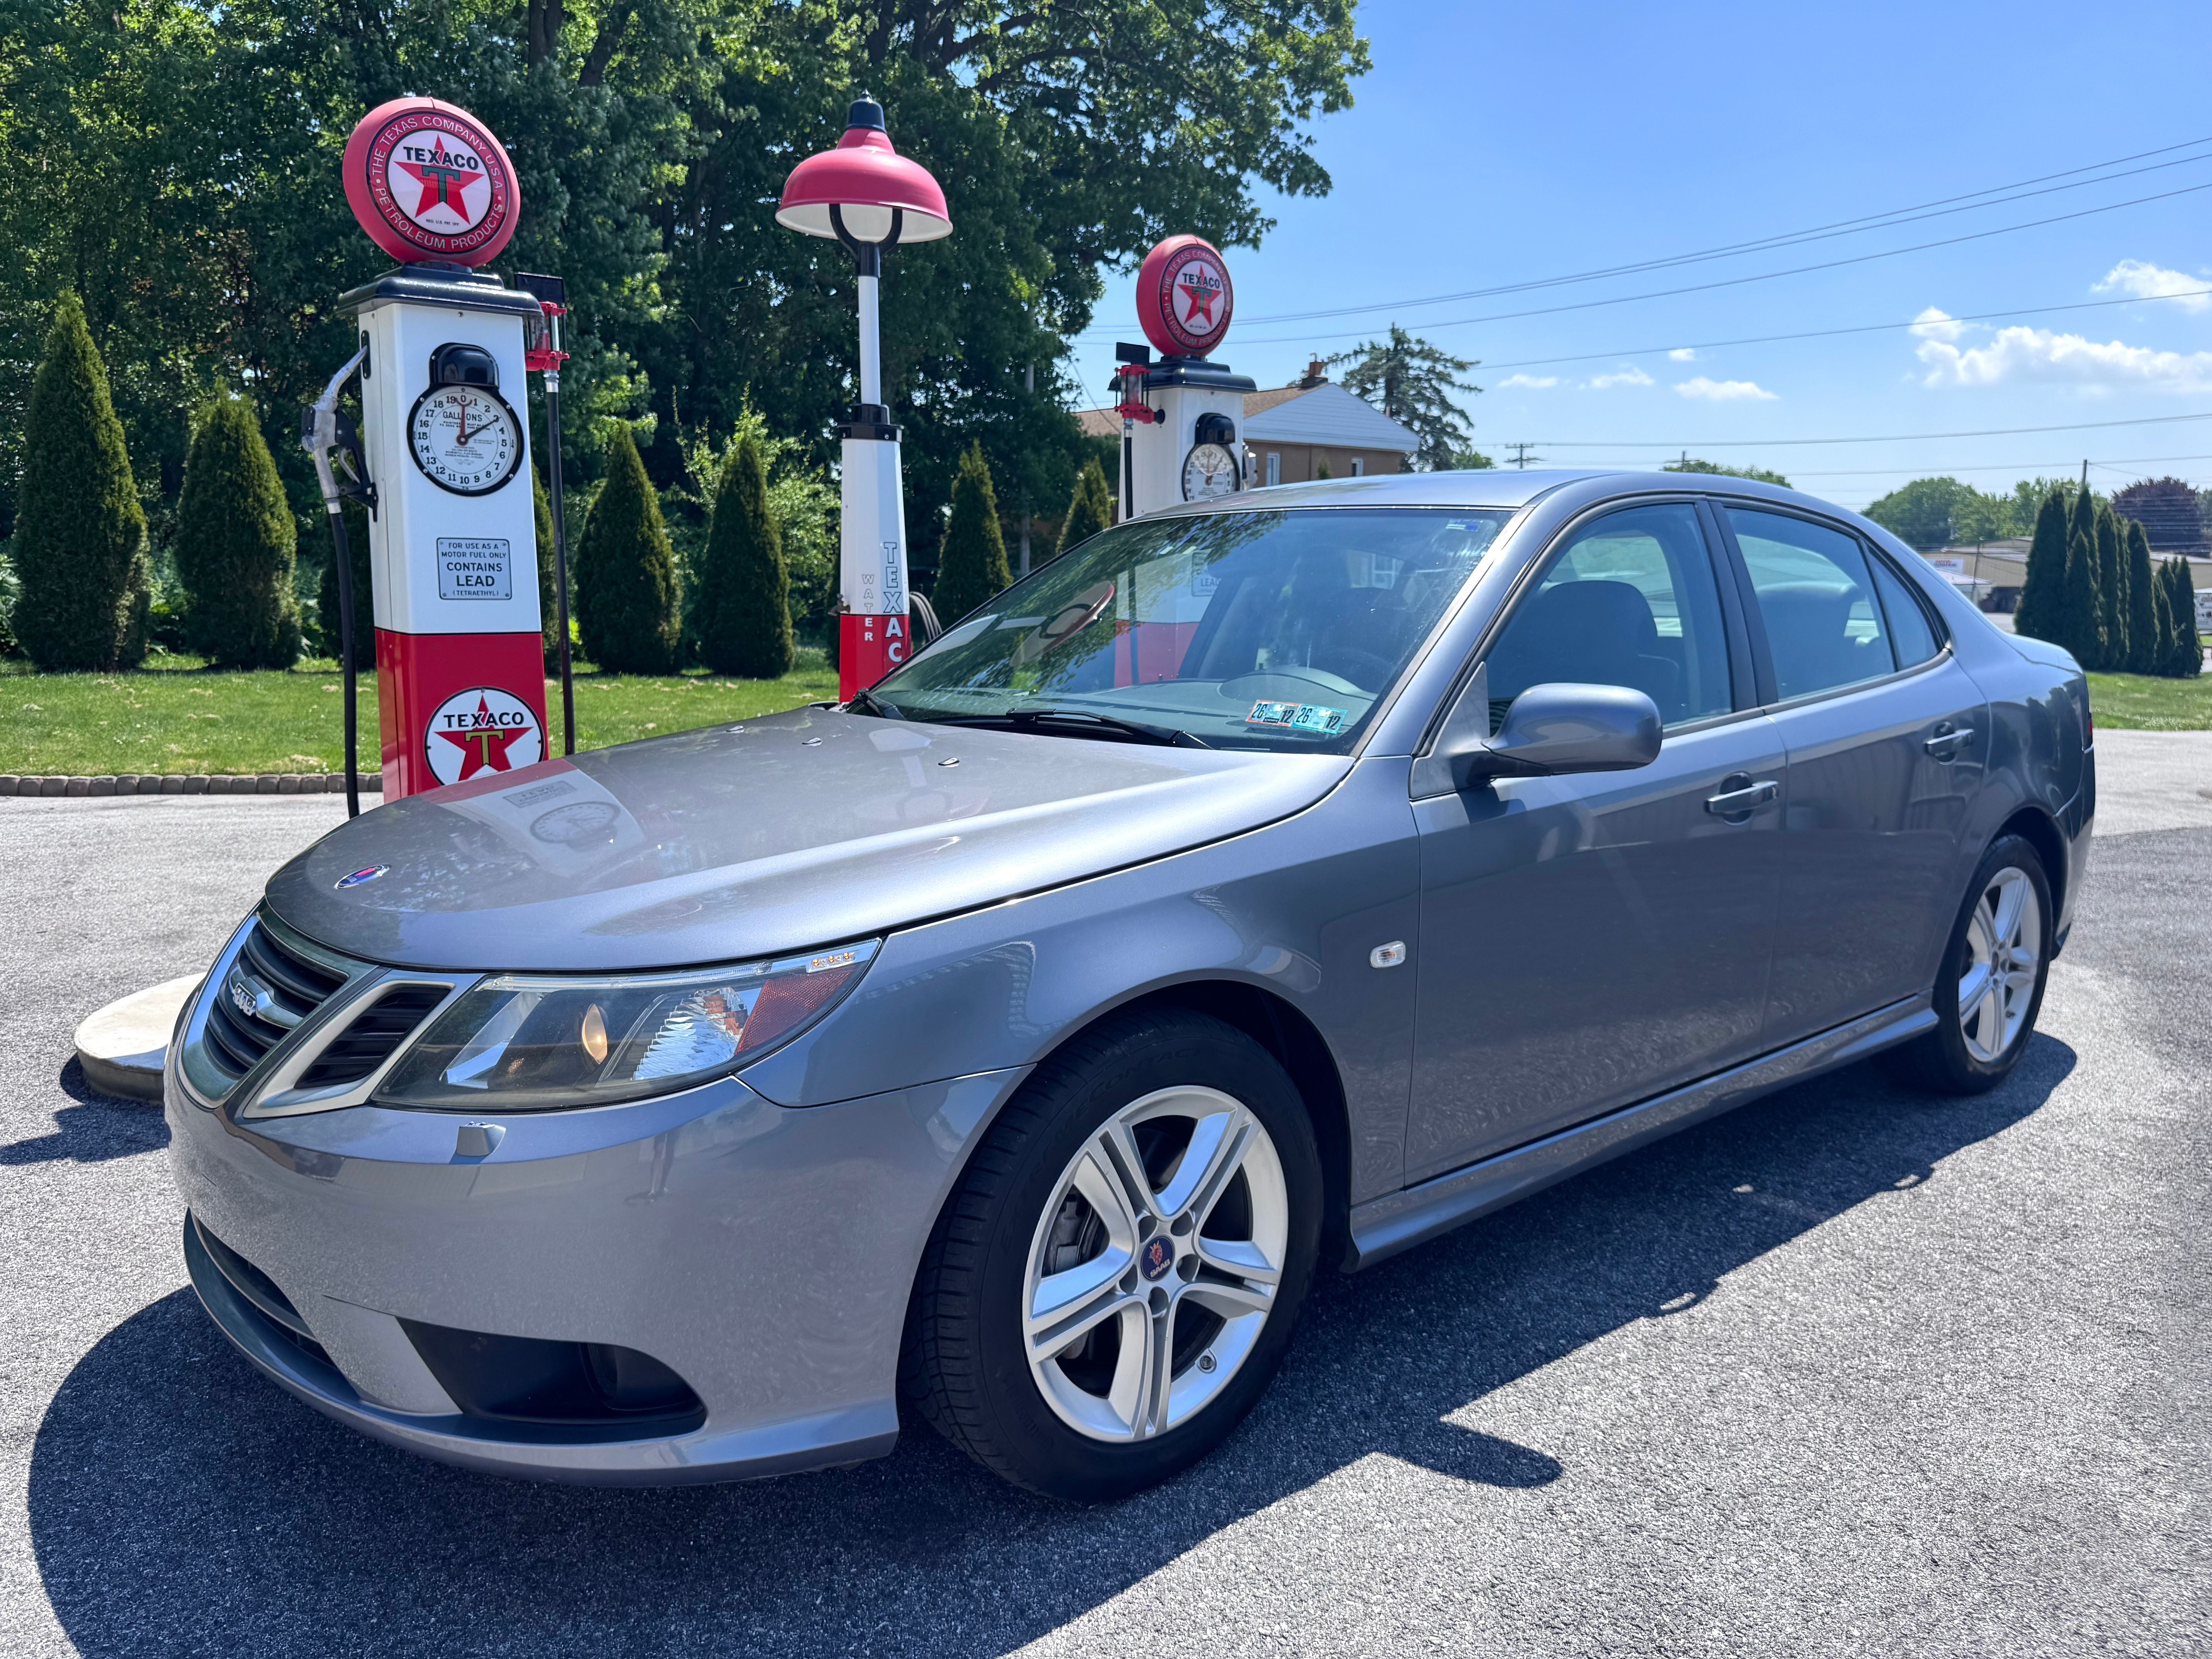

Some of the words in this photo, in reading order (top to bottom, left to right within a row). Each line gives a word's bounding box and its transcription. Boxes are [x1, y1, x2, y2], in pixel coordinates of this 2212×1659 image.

[372, 148, 386, 176] THE
[380, 117, 418, 146] TEXAS
[422, 117, 486, 151] COMPANY
[403, 146, 479, 170] TEXACO
[375, 188, 445, 249] PETROLEUM
[451, 204, 503, 249] PRODUCTS
[1164, 276, 1173, 294] THE
[1170, 252, 1190, 273] TEXAS
[1182, 273, 1219, 289] TEXACO
[1163, 303, 1197, 345] PETROLEUM
[447, 562, 502, 572] CONTAINS
[457, 575, 495, 587] LEAD
[862, 574, 874, 642] WATER
[883, 542, 903, 673] TEXAC
[443, 712, 524, 728] TEXACO
[1251, 703, 1267, 718] 26
[1279, 710, 1295, 723] 12
[1296, 707, 1312, 723] 26
[1325, 716, 1341, 730] 12
[1150, 1259, 1170, 1278] SAAB
